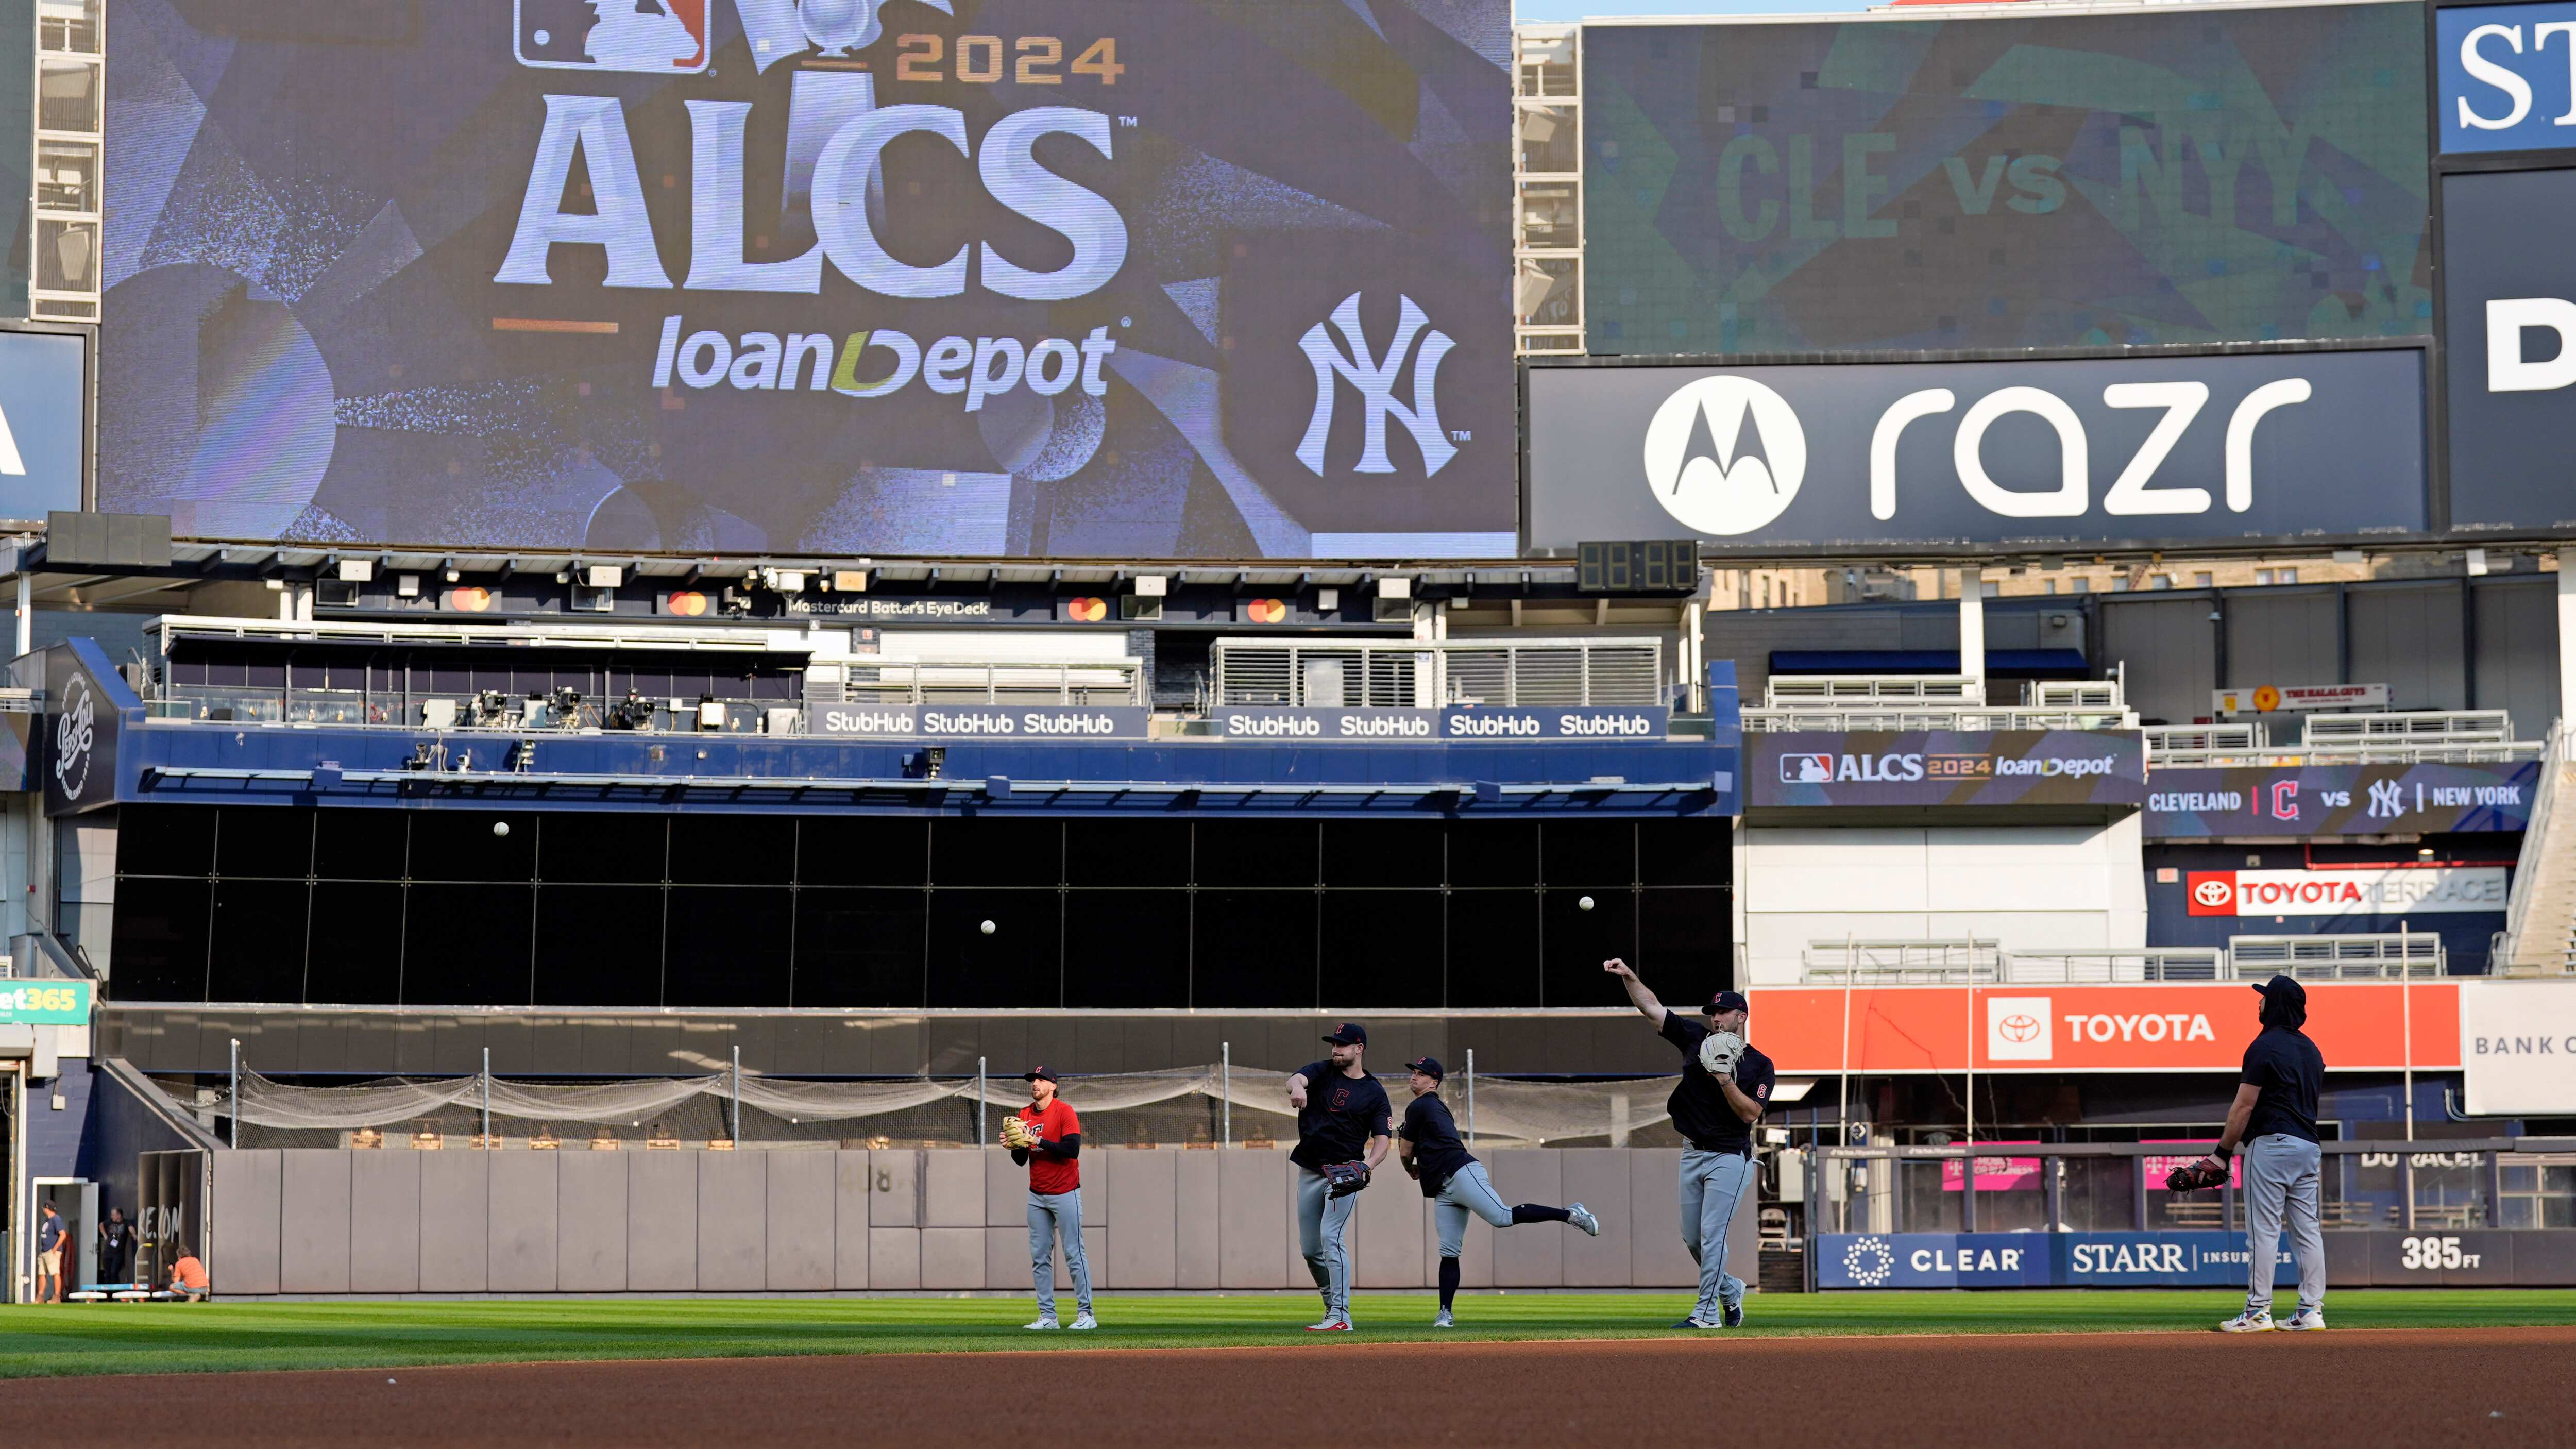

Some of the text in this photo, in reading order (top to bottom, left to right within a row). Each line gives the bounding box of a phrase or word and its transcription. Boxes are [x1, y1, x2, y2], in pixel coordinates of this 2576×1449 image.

[896, 34, 1125, 85] 2024
[1717, 132, 1898, 242] CLE
[2119, 120, 2319, 231] NYY
[493, 94, 1127, 300] ALCS
[1870, 378, 2311, 520] razr
[788, 598, 868, 614] Mastercard
[927, 601, 953, 617] Eye
[953, 602, 989, 615] Deck
[826, 711, 1114, 734] StubHub StubHub StubHub
[1229, 715, 1430, 736] StubHub StubHub
[1450, 715, 1650, 735] StubHub StubHub
[1836, 754, 1925, 782] ALCS
[1928, 760, 1992, 774] 2024
[2149, 791, 2242, 812] CLEVELAND
[2433, 787, 2472, 806] NEW
[2475, 786, 2521, 805] YORK
[2241, 877, 2503, 905] TOYOTA TERRACE
[2064, 1014, 2215, 1042] TOYOTA
[2476, 1037, 2554, 1054] BANK
[1757, 1084, 1767, 1098] 6
[1911, 1248, 2020, 1272] CLEAR
[2072, 1243, 2292, 1273] STARR INSURCE
[2402, 1237, 2462, 1269] 385
